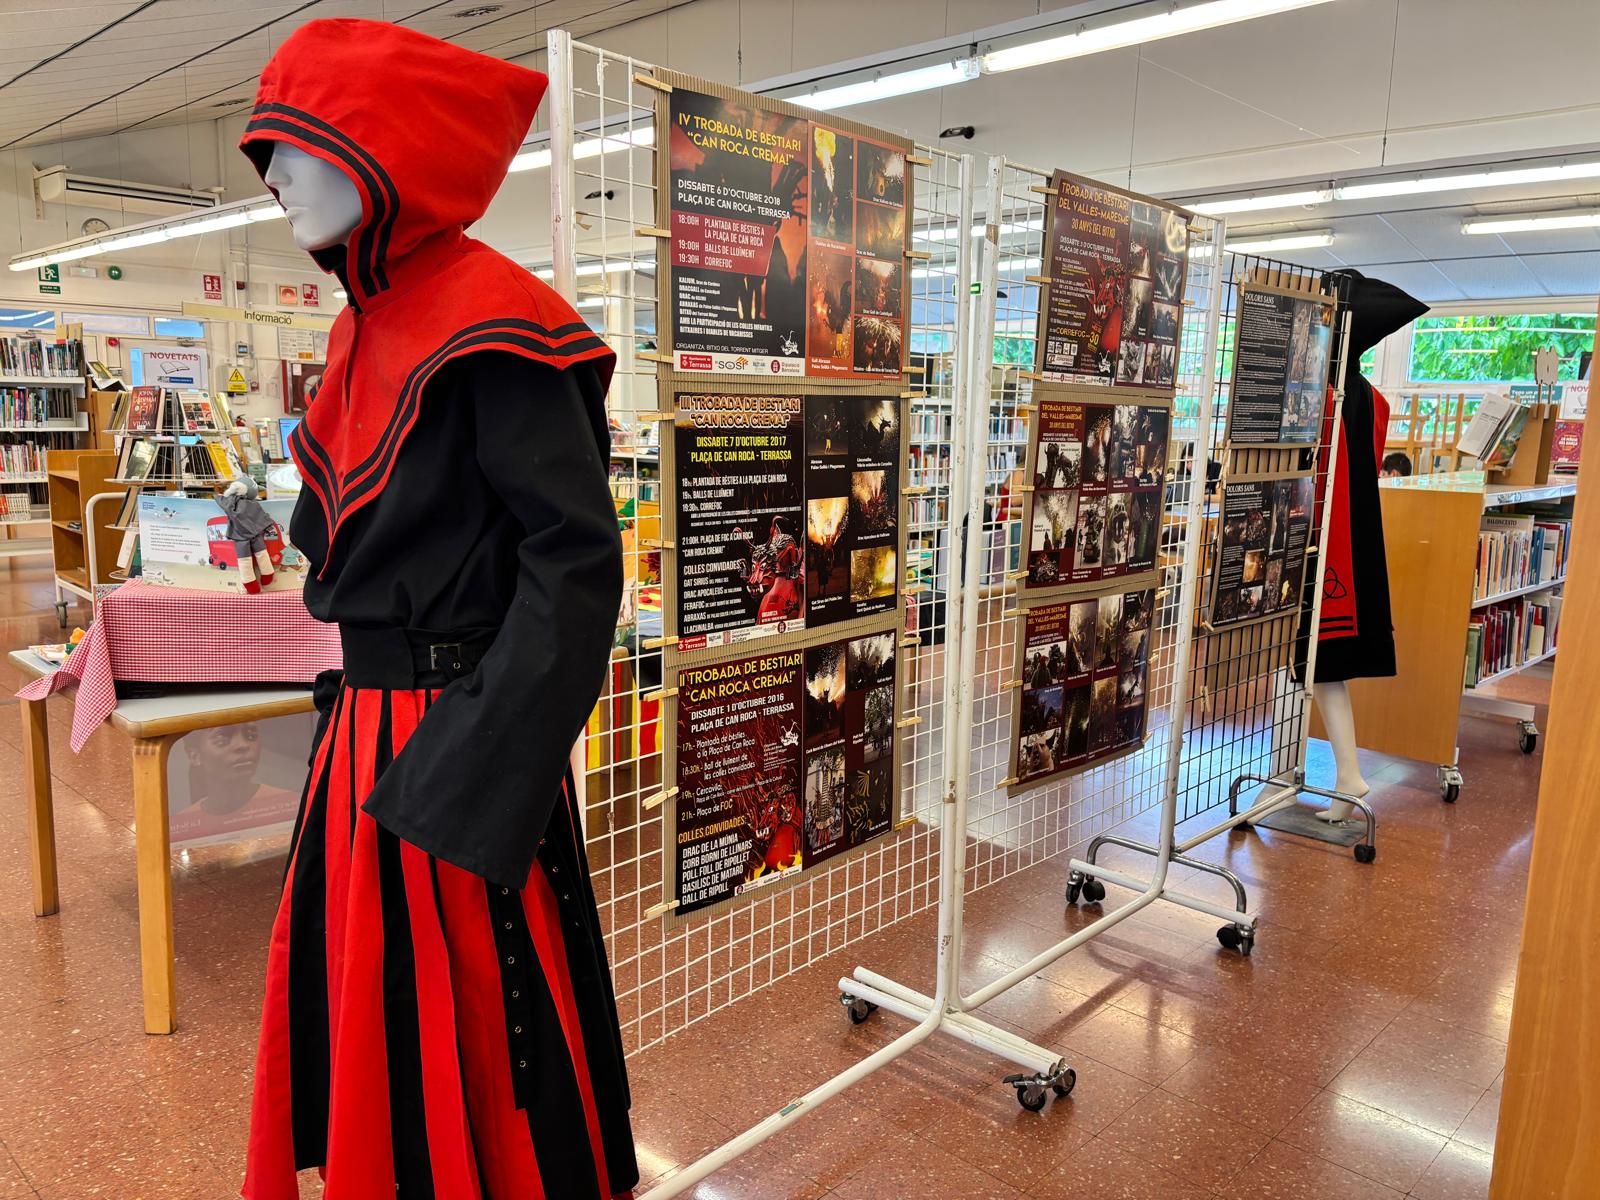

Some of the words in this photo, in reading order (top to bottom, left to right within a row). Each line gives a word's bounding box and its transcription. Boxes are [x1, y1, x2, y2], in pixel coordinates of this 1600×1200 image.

[679, 113, 691, 125] IV
[694, 116, 743, 139] TROBADA
[746, 129, 758, 142] DE
[761, 132, 801, 151] BESTIARI
[720, 139, 749, 156] ROCA
[678, 179, 715, 193] DISSABTE
[717, 186, 721, 194] 6
[723, 187, 762, 202] D'OCTUBRE
[764, 196, 781, 205] 2018
[1062, 183, 1093, 200] TROBADA
[1095, 191, 1102, 203] DE
[1104, 195, 1128, 211] BESTIARI
[678, 193, 703, 205] PLAÇA
[705, 197, 714, 206] DE
[717, 199, 731, 209] CAN
[758, 206, 791, 219] TERRASSA
[1059, 197, 1070, 210] DEL
[705, 218, 731, 230] PLANTADA
[732, 223, 739, 232] DE
[761, 227, 764, 236] A
[1072, 218, 1078, 229] 30
[1079, 220, 1092, 233] ANYS
[1093, 223, 1101, 235] DEL
[679, 239, 699, 251] 19:00H
[705, 230, 711, 238] LA
[713, 231, 729, 243] PLAÇA
[731, 234, 737, 243] DE
[739, 235, 748, 245] CAN
[750, 236, 763, 247] ROCA
[705, 243, 721, 253] BALLS
[722, 246, 729, 255] DE
[679, 253, 699, 264] 19:30H
[705, 256, 732, 268] CORREFOC
[1245, 293, 1263, 303] DOLORS
[244, 311, 292, 325] Informació
[150, 352, 200, 360] NOVETATS
[680, 396, 691, 411] III
[693, 396, 742, 412] TROBADA
[743, 398, 758, 412] DE
[759, 398, 801, 413] BESTIARI
[720, 413, 750, 428] ROCA
[697, 437, 728, 447] DISSABTE
[730, 437, 734, 446] 7
[736, 436, 769, 446] D'OCTUBRE
[771, 436, 787, 446] 2017
[691, 452, 712, 463] PLAÇA
[714, 452, 722, 462] DE
[724, 452, 737, 461] CAN
[739, 451, 755, 461] ROCA
[761, 450, 792, 460] TERRASSA
[693, 477, 715, 487] PLANTADA
[715, 477, 721, 485] DE
[743, 475, 748, 484] LA
[749, 475, 761, 485] PLAÇA
[761, 475, 767, 483] DE
[768, 474, 776, 483] CAN
[693, 490, 706, 499] BALLS
[707, 490, 713, 498] DE
[700, 502, 722, 511] CORREFOC
[700, 534, 714, 544] PLAÇA
[715, 534, 721, 542] DE
[721, 533, 729, 542] FOC
[684, 564, 705, 575] COLLES
[684, 590, 697, 599] DRAC
[679, 674, 685, 687] II
[688, 665, 742, 685] TROBADA
[745, 661, 757, 674] DE
[760, 653, 803, 671] BESTIARI
[719, 681, 751, 697] ROCA
[691, 706, 724, 720] DISSABTE
[727, 704, 730, 712] 1
[732, 696, 766, 711] D'OCTUBRE
[767, 693, 784, 704] 2016
[691, 721, 714, 733] PLAÇA
[715, 718, 724, 727] DE
[725, 715, 739, 726] CAN
[740, 711, 757, 722] ROCA
[763, 702, 794, 716] TERRASSA
[696, 738, 720, 748] Plantada
[702, 749, 708, 757] la
[709, 746, 723, 757] Plaça
[732, 741, 742, 749] Can
[743, 739, 755, 747] Roca
[715, 760, 721, 768] de
[741, 753, 748, 761] de
[696, 806, 712, 817] Plaça
[720, 799, 733, 811] FOC
[678, 827, 704, 844] COLLES
[683, 845, 700, 858] DRAC
[701, 842, 709, 853] DE
[710, 839, 719, 850] LA
[683, 856, 699, 870] CORB
[721, 848, 728, 858] DE
[683, 870, 698, 883] POLL
[699, 865, 714, 878] FOLL
[715, 861, 723, 872] DE
[724, 851, 750, 870] RIPOLLET
[712, 874, 720, 885] DE
[682, 891, 698, 905] GALL
[700, 888, 708, 899] DE
[709, 882, 729, 897] RIPOLL
